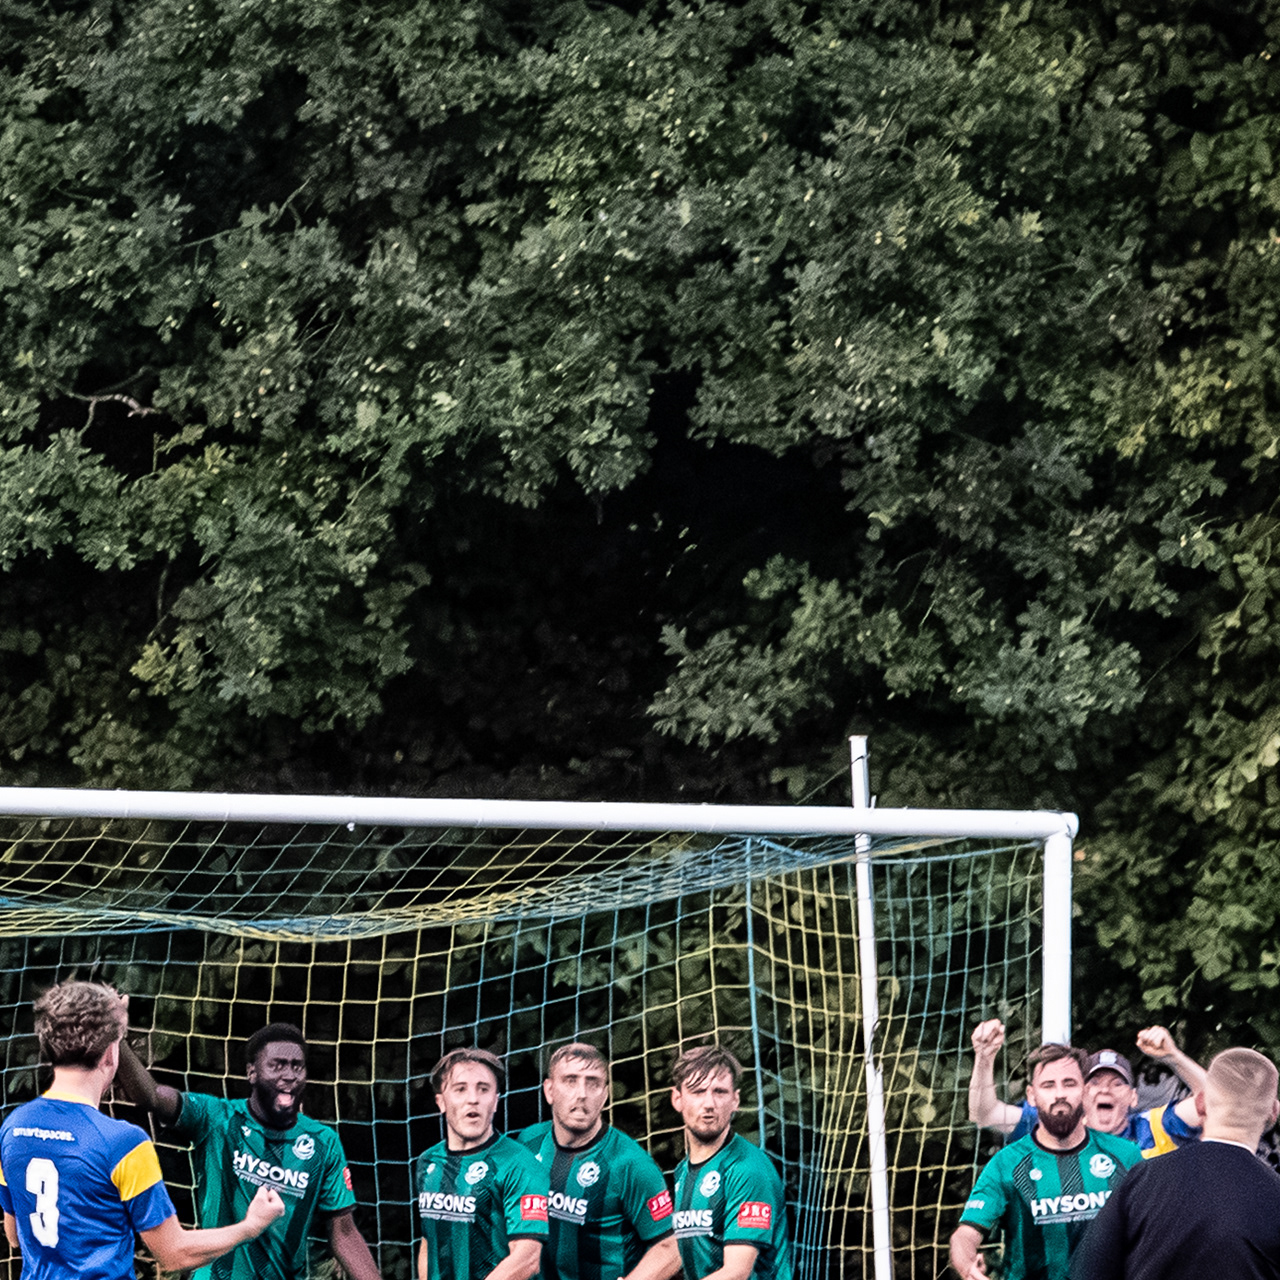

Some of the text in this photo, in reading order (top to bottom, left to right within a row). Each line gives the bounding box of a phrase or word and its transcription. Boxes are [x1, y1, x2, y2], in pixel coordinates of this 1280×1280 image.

[233, 1149, 310, 1189] HYSONS
[25, 1157, 60, 1249] 3
[419, 1191, 477, 1214] HYSONS
[523, 1196, 548, 1212] JRC
[740, 1203, 771, 1219] JRC
